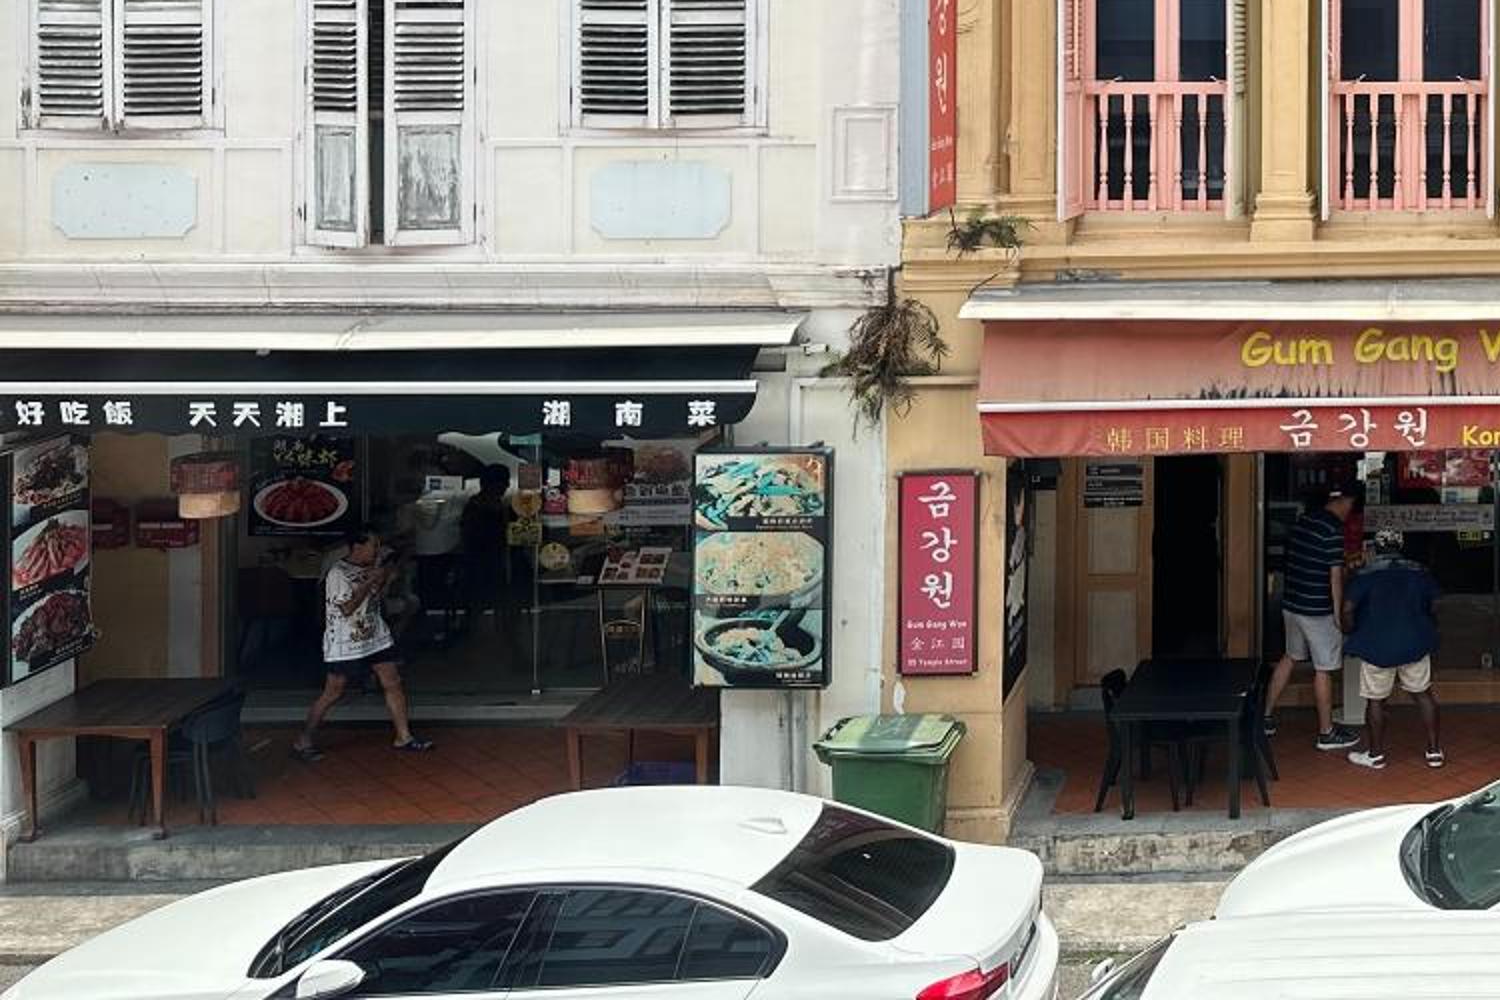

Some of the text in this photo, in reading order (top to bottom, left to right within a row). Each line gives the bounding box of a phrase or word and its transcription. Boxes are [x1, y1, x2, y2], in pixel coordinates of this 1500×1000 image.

[1241, 331, 1335, 368] Gum
[1354, 328, 1459, 373] Gang
[189, 401, 348, 427] 天天湘上
[543, 400, 716, 427] 湖南菜
[1280, 407, 1428, 447] 금강원
[917, 481, 958, 609] 금강원
